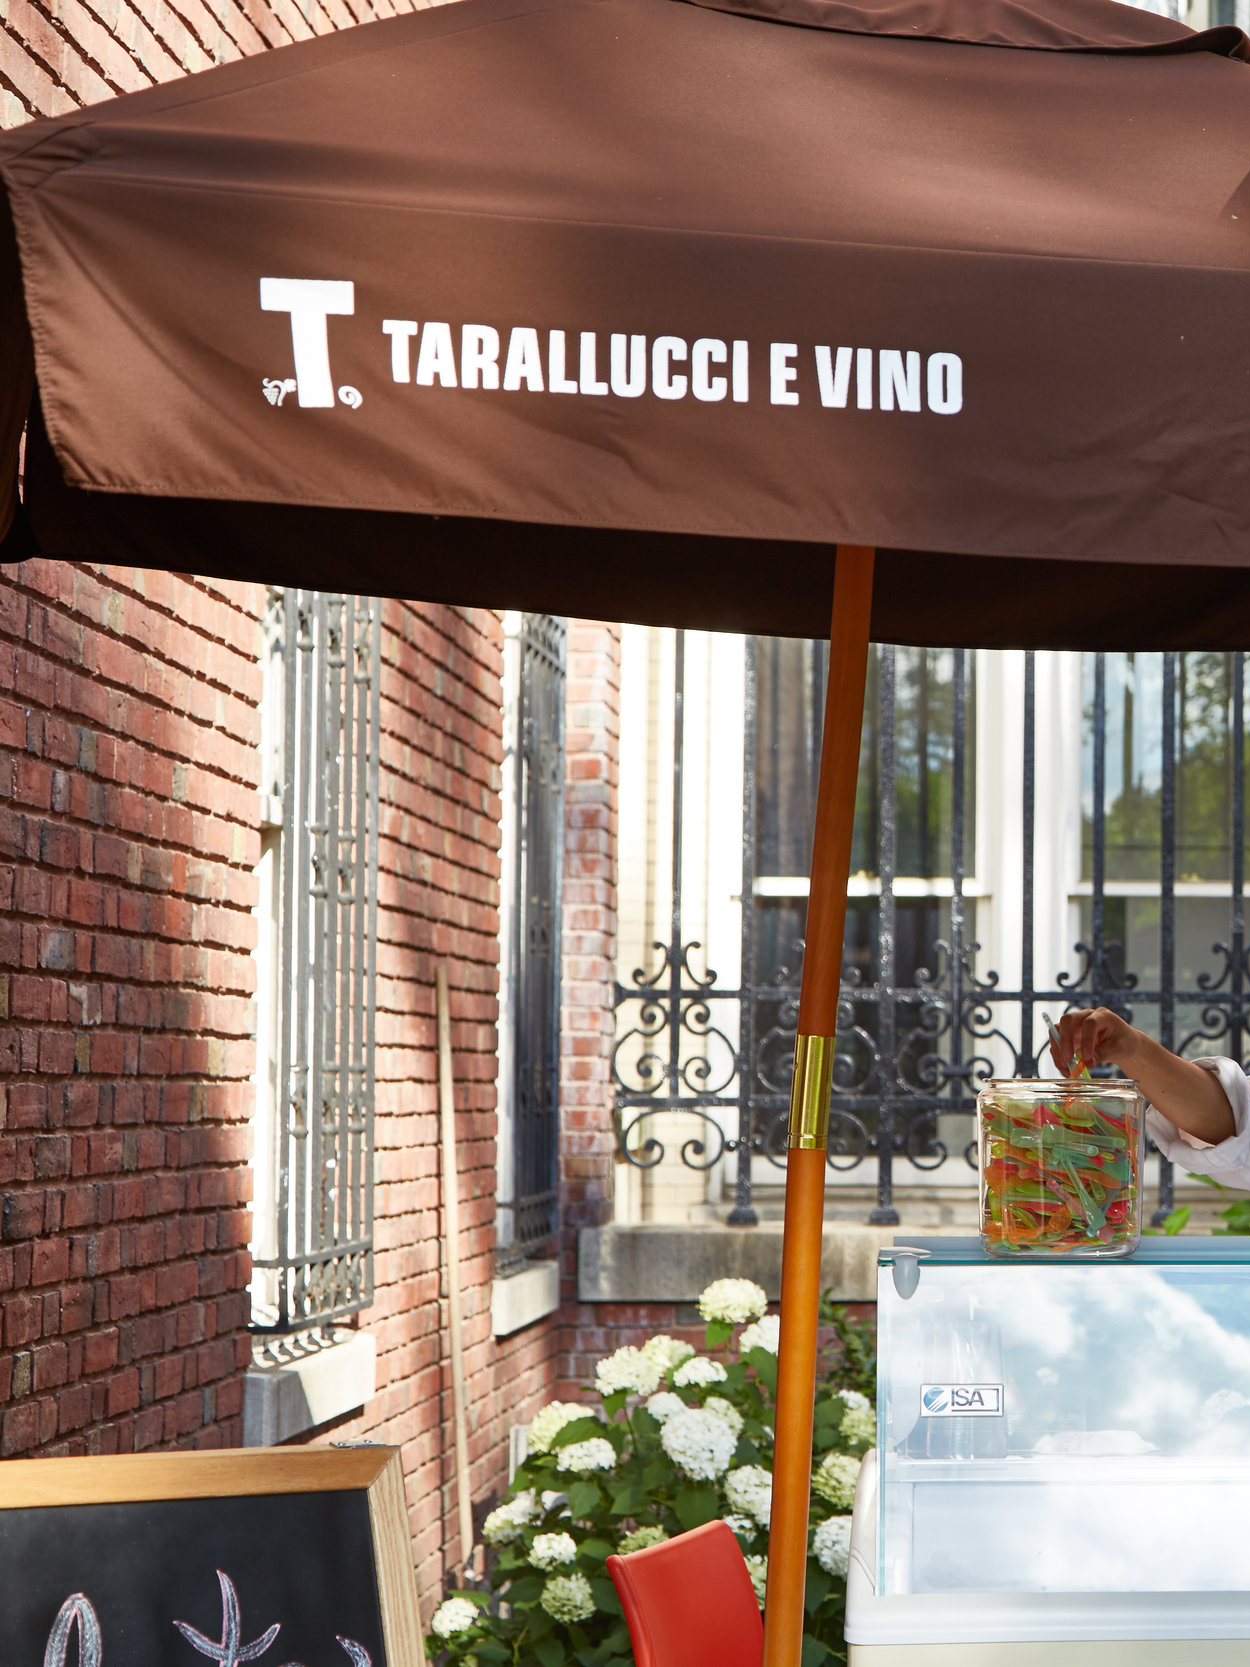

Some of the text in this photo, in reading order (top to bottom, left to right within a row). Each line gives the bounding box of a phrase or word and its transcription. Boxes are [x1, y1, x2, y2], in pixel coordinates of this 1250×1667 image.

[382, 319, 963, 415] TARALLUCCI E VINO
[951, 1388, 985, 1407] ISA
